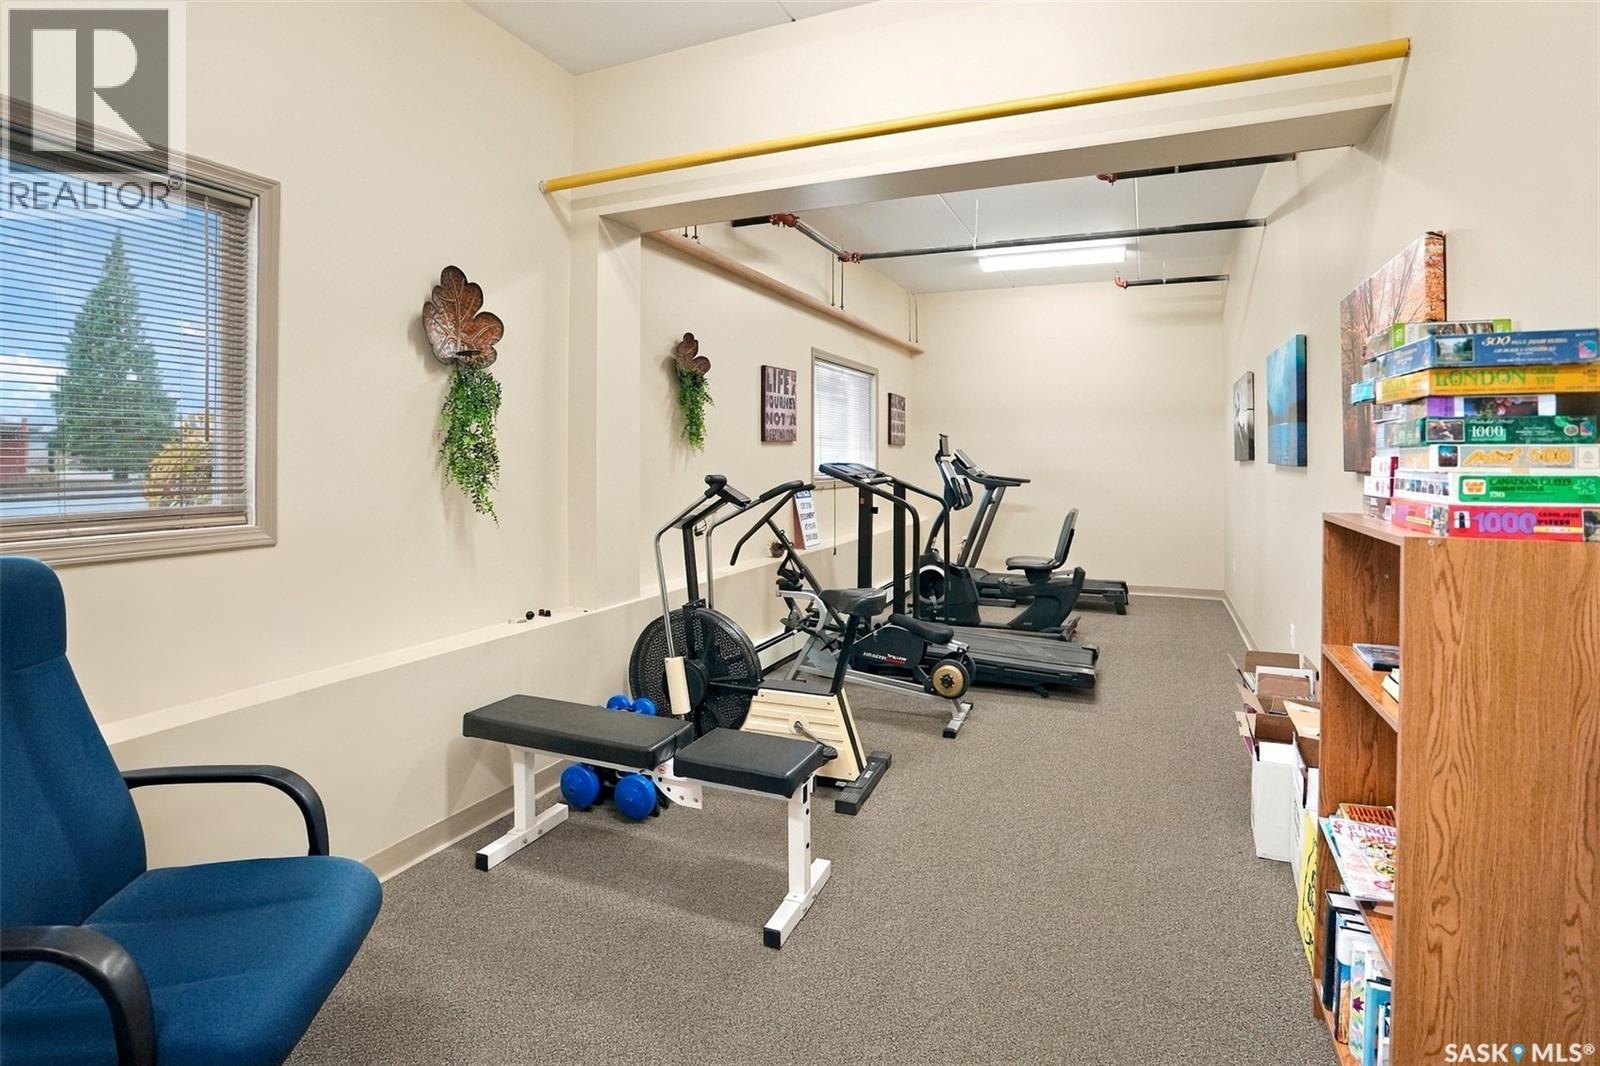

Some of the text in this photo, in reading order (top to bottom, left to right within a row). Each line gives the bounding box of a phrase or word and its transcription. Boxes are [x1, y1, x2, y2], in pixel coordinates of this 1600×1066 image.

[766, 368, 790, 395] LIFE
[1435, 367, 1527, 387] LONDON
[765, 394, 797, 410] JOURNEY
[765, 412, 786, 426] NOT
[1471, 425, 1504, 437] 1000
[1472, 511, 1537, 534] 1000
